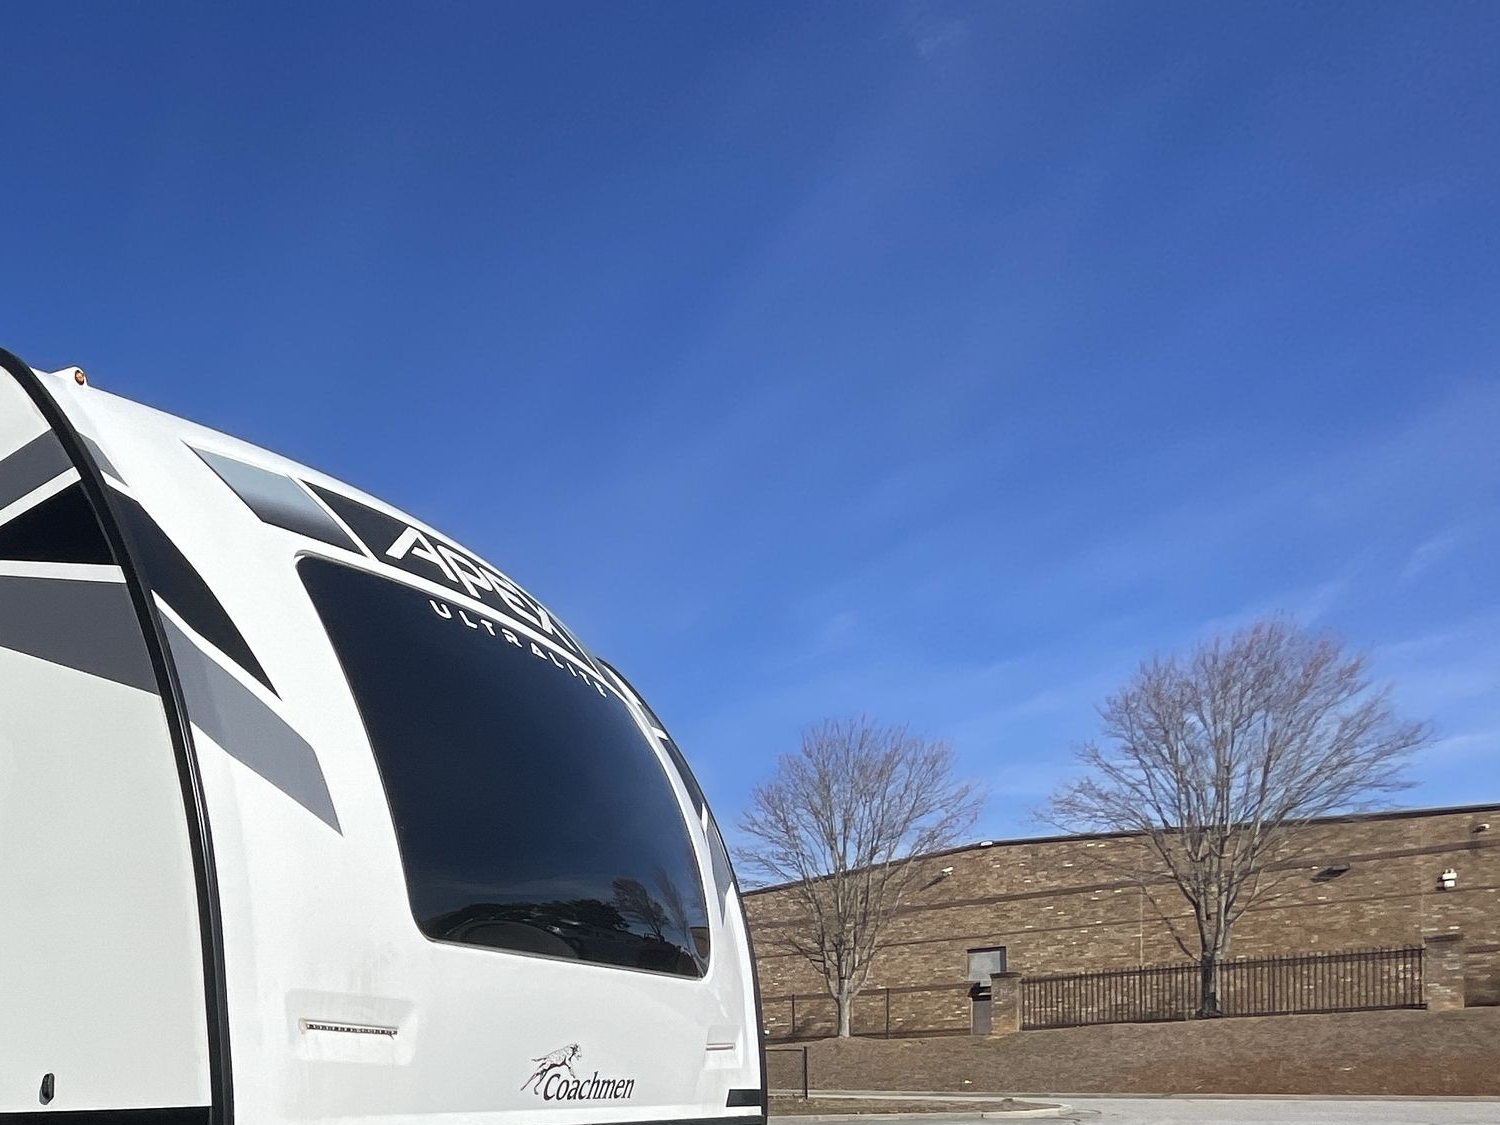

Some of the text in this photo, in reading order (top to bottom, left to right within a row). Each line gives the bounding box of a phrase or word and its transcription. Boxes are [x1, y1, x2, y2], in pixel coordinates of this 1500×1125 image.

[385, 526, 577, 653] APEX
[429, 599, 607, 698] ULTRALITE
[543, 1071, 635, 1101] Coachmen
